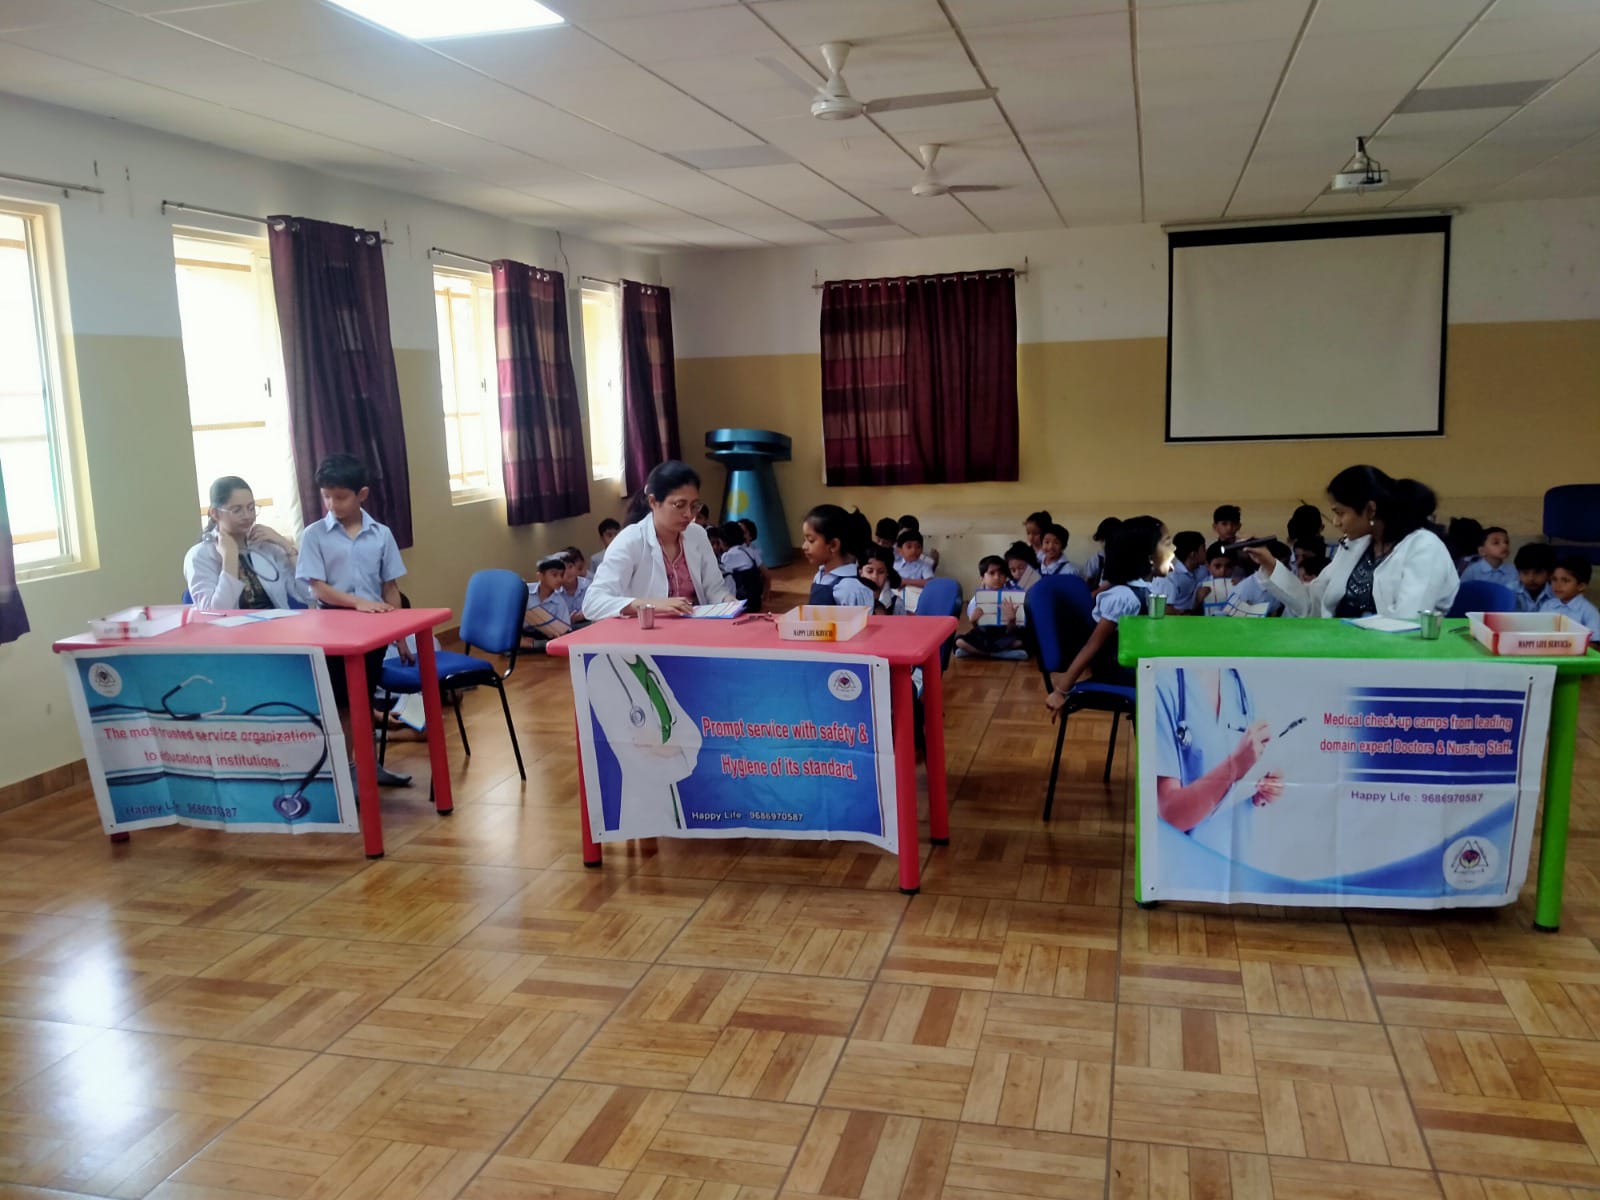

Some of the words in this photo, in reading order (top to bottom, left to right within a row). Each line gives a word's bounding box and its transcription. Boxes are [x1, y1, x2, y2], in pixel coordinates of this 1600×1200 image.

[1518, 640, 1534, 648] HAPPY
[1323, 712, 1362, 726] Medical
[1364, 713, 1411, 731] check-up
[1414, 715, 1449, 732] camps
[1450, 714, 1473, 729] from
[1475, 714, 1512, 732] leading
[104, 728, 126, 739] The
[195, 728, 237, 742] service
[240, 729, 316, 745] organization
[702, 716, 745, 740] Prompt
[747, 719, 789, 738] service
[792, 720, 817, 739] with
[820, 722, 856, 746] safety
[859, 723, 869, 743] &
[144, 750, 157, 761] to
[1320, 739, 1356, 752] domain
[1359, 740, 1392, 756] expert
[1393, 739, 1434, 754] Doctors
[1436, 739, 1445, 754] &
[1447, 741, 1485, 757] Nursing
[1487, 740, 1512, 755] Staff.
[721, 755, 767, 779] Hygiene
[771, 758, 783, 776] of
[785, 757, 800, 776] its
[803, 758, 857, 780] standard.
[1351, 790, 1386, 802] Happy
[1390, 791, 1410, 801] Life
[691, 811, 721, 821] Happy
[724, 811, 742, 820] Life
